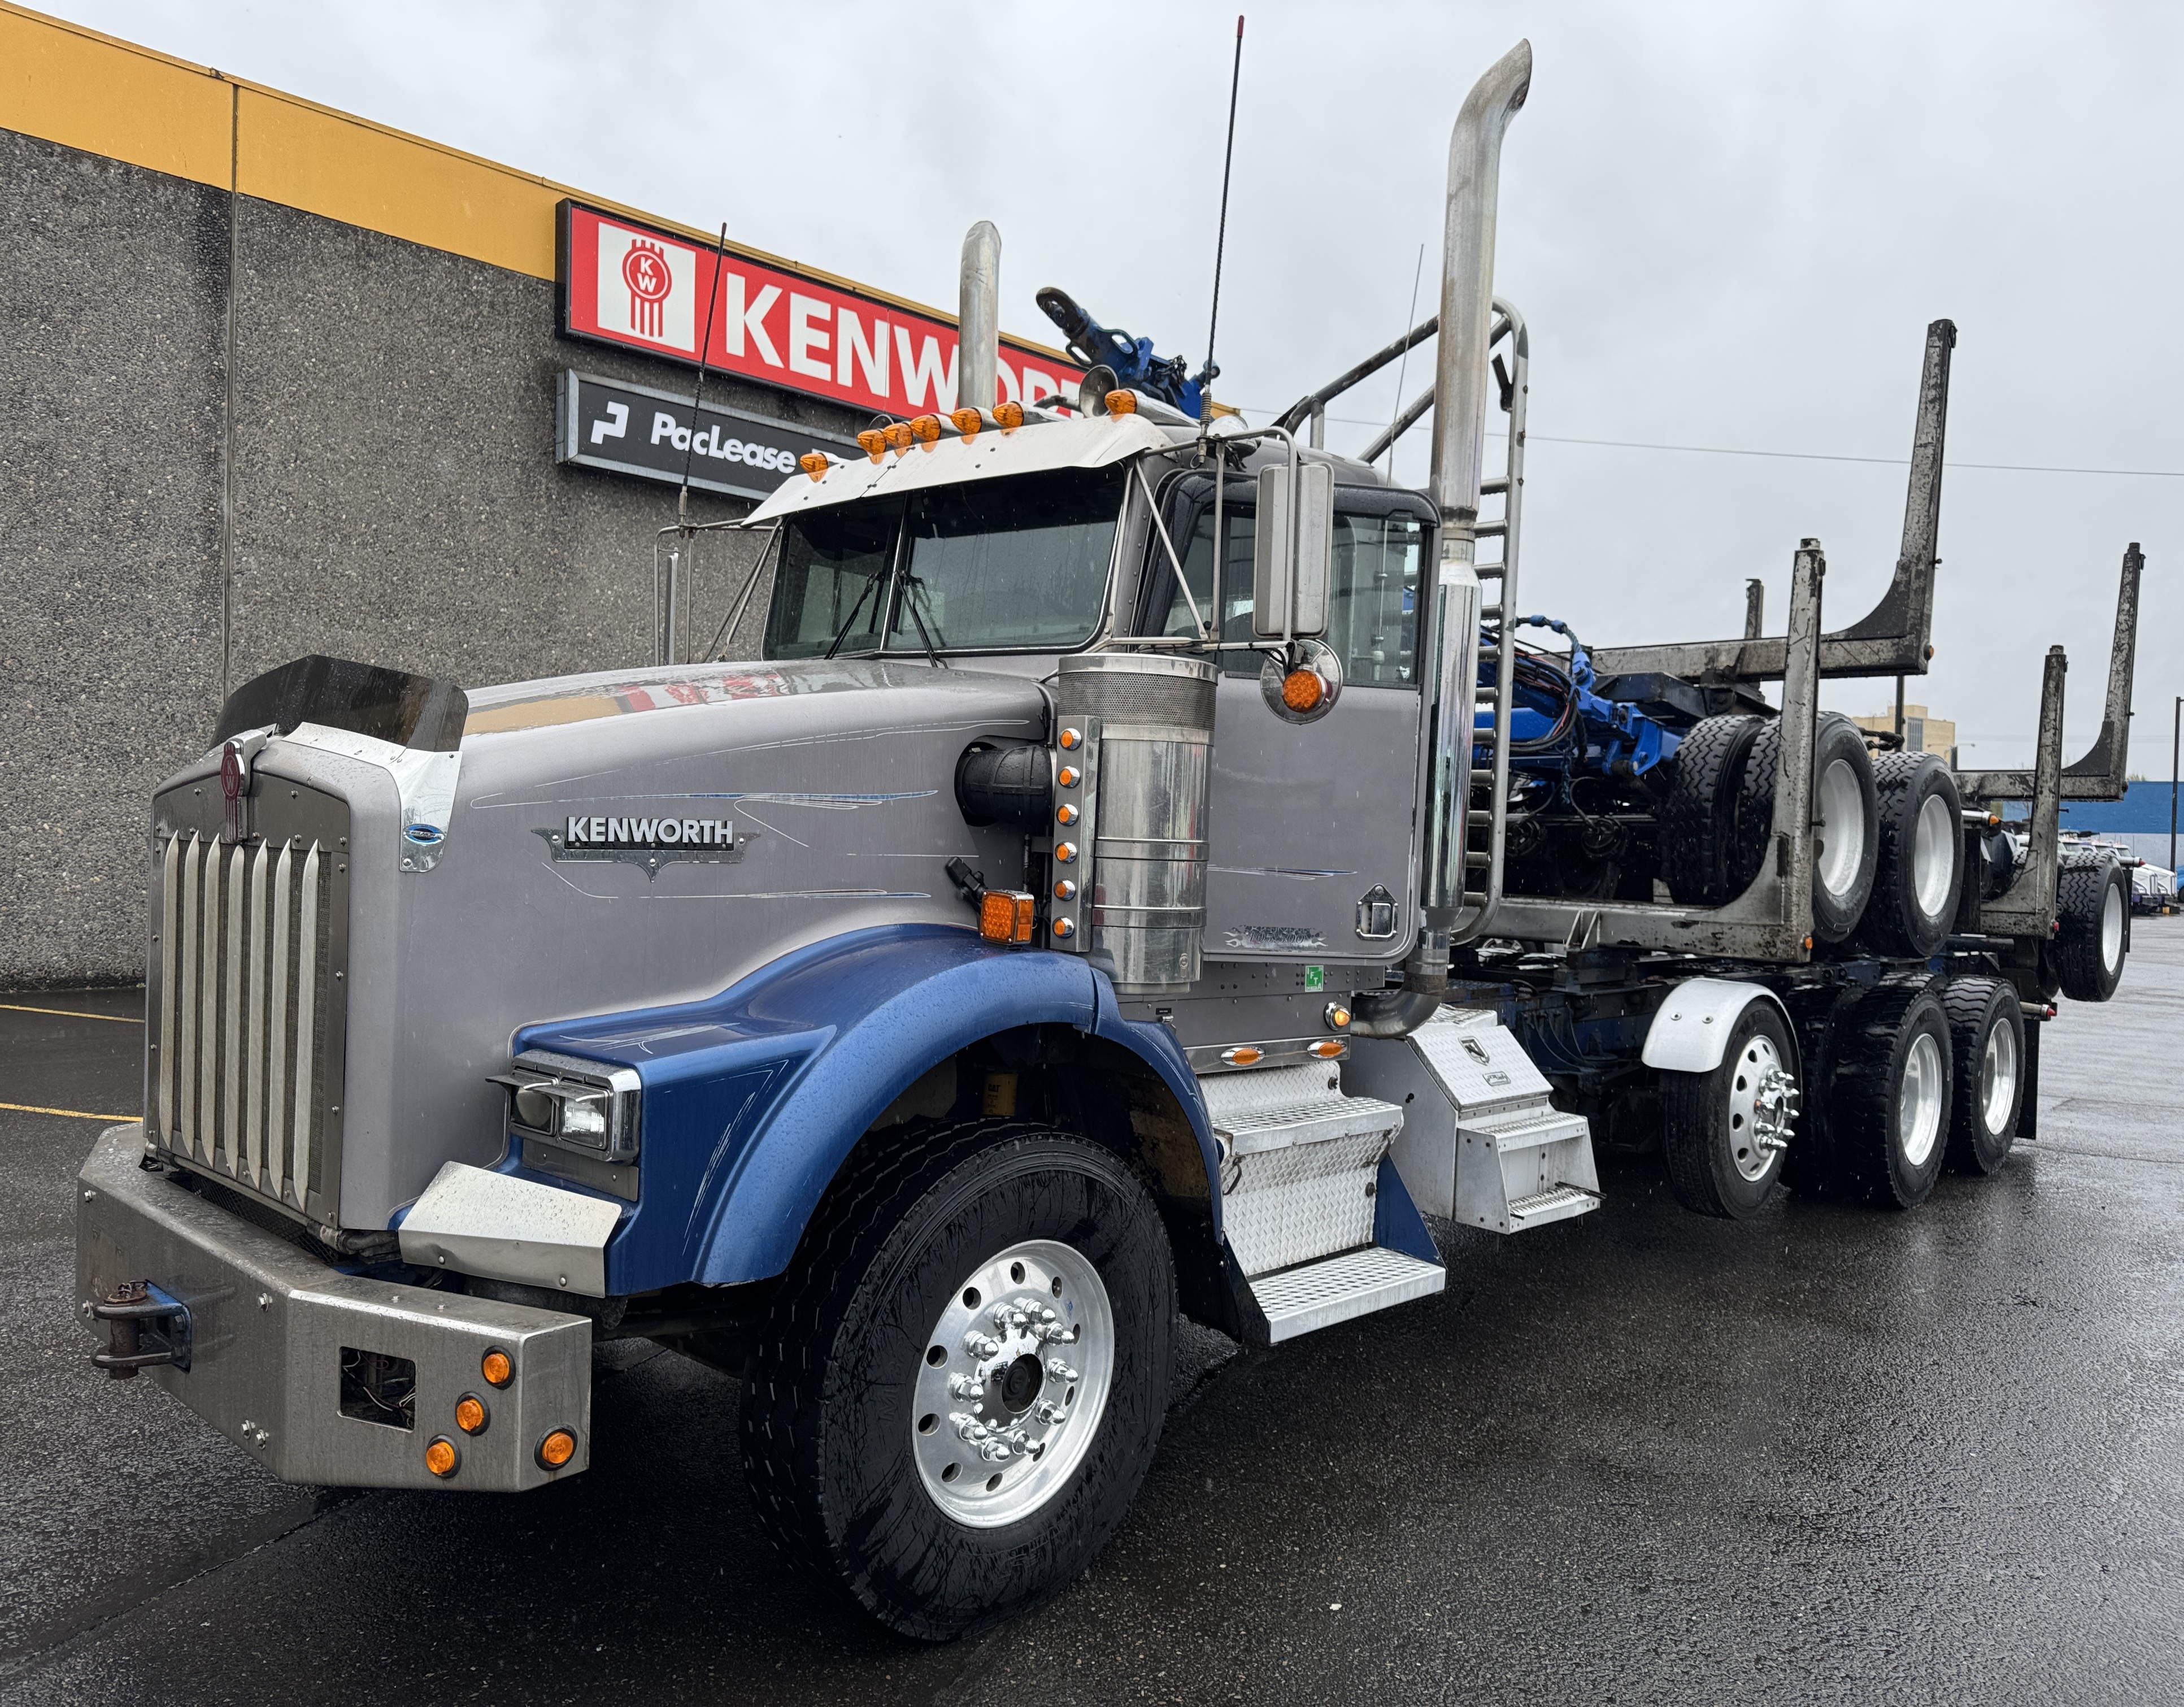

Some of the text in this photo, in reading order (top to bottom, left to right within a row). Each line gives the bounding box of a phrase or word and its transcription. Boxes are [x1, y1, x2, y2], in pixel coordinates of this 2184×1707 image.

[650, 411, 797, 474] PacLease
[567, 816, 733, 844] KENWORTH
[988, 1083, 1002, 1092] CAT
